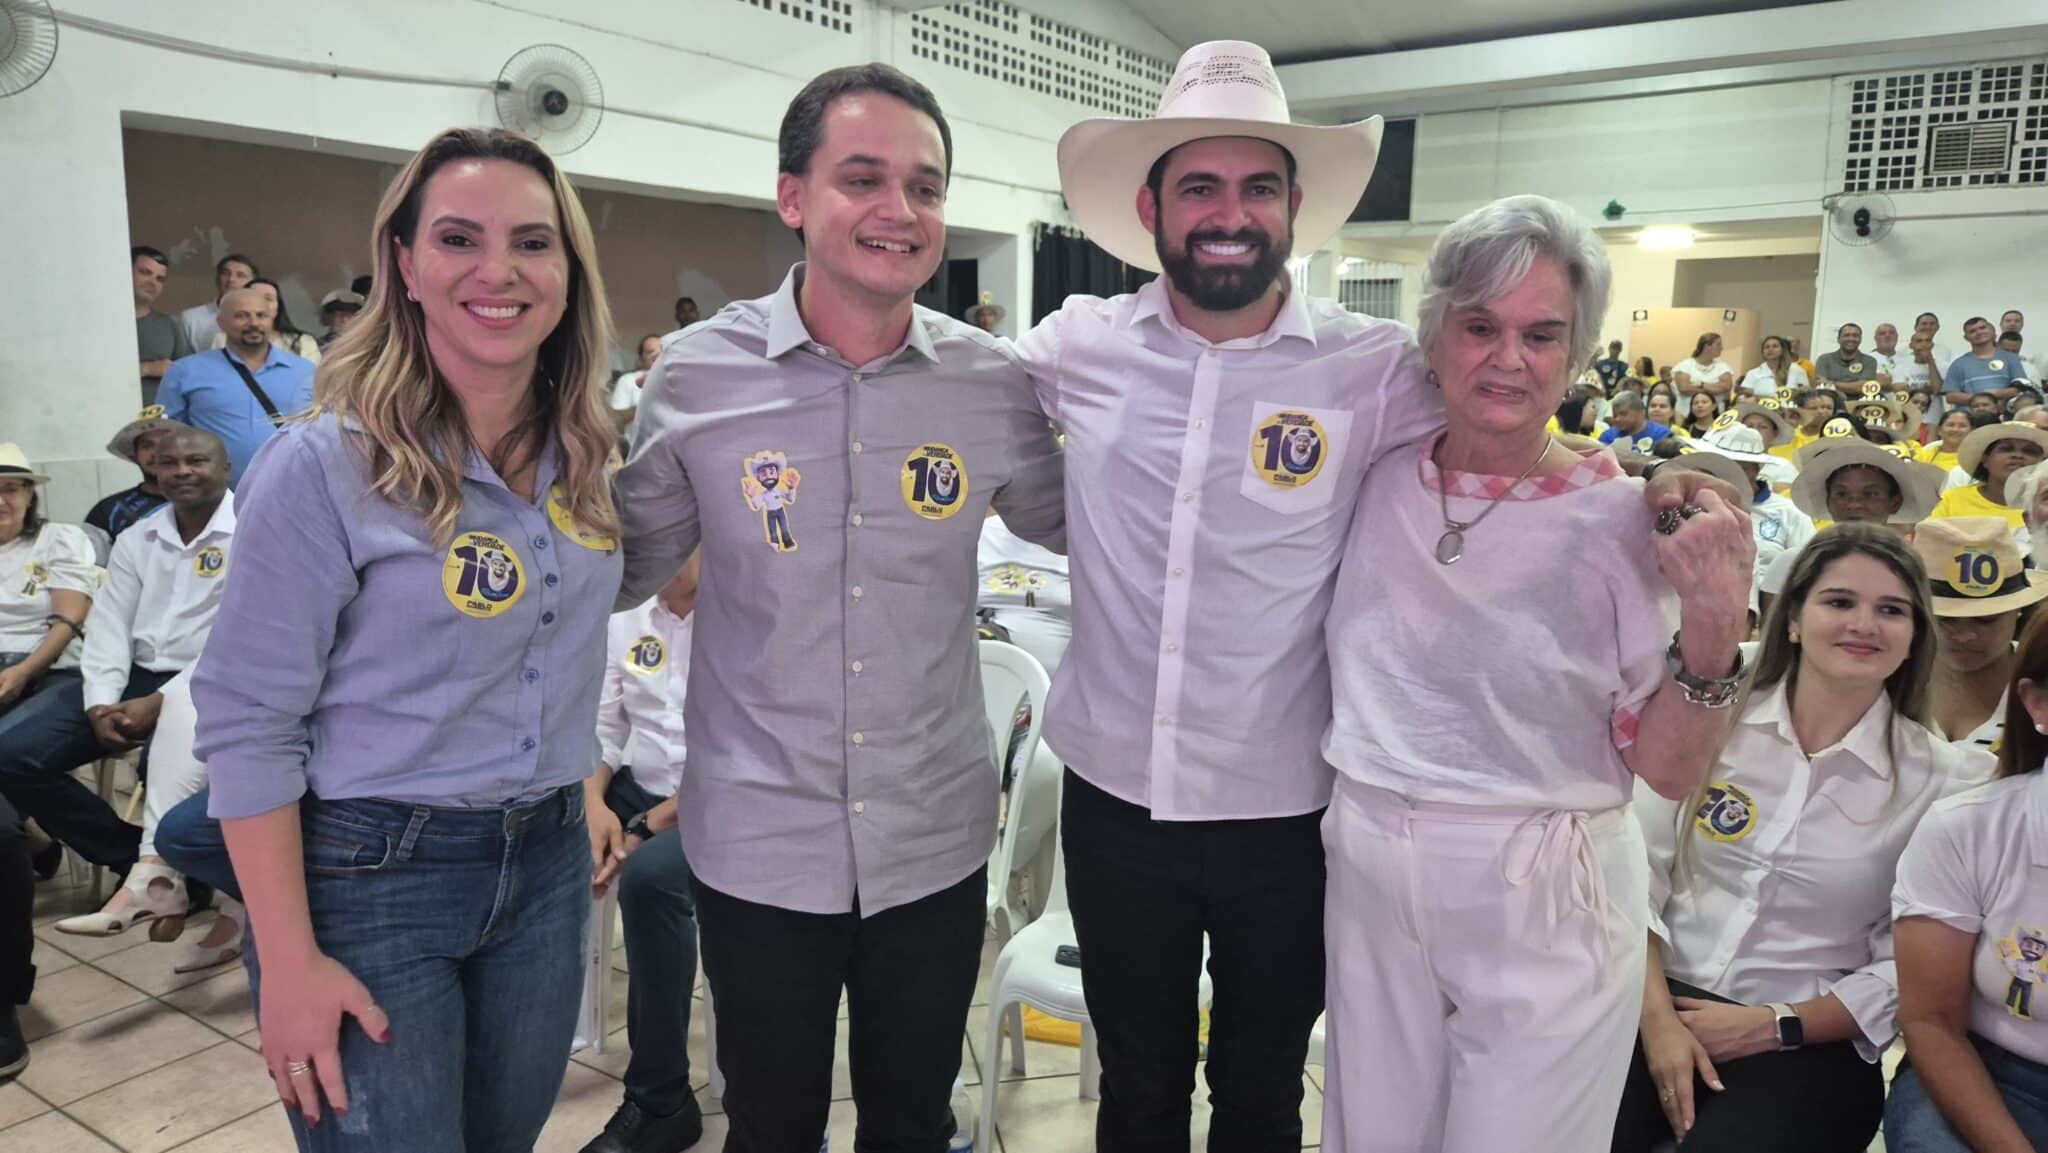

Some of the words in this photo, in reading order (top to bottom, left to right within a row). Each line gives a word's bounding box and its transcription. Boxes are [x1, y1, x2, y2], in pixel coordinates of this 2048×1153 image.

[1864, 384, 1878, 393] 10
[1864, 409, 1881, 417] 10
[1260, 424, 1321, 474] 10
[908, 457, 960, 506] 10
[198, 551, 224, 570] 10
[454, 546, 519, 602] 10
[1954, 553, 1999, 585] 10
[631, 644, 663, 667] 10
[1696, 788, 1750, 835] 10
